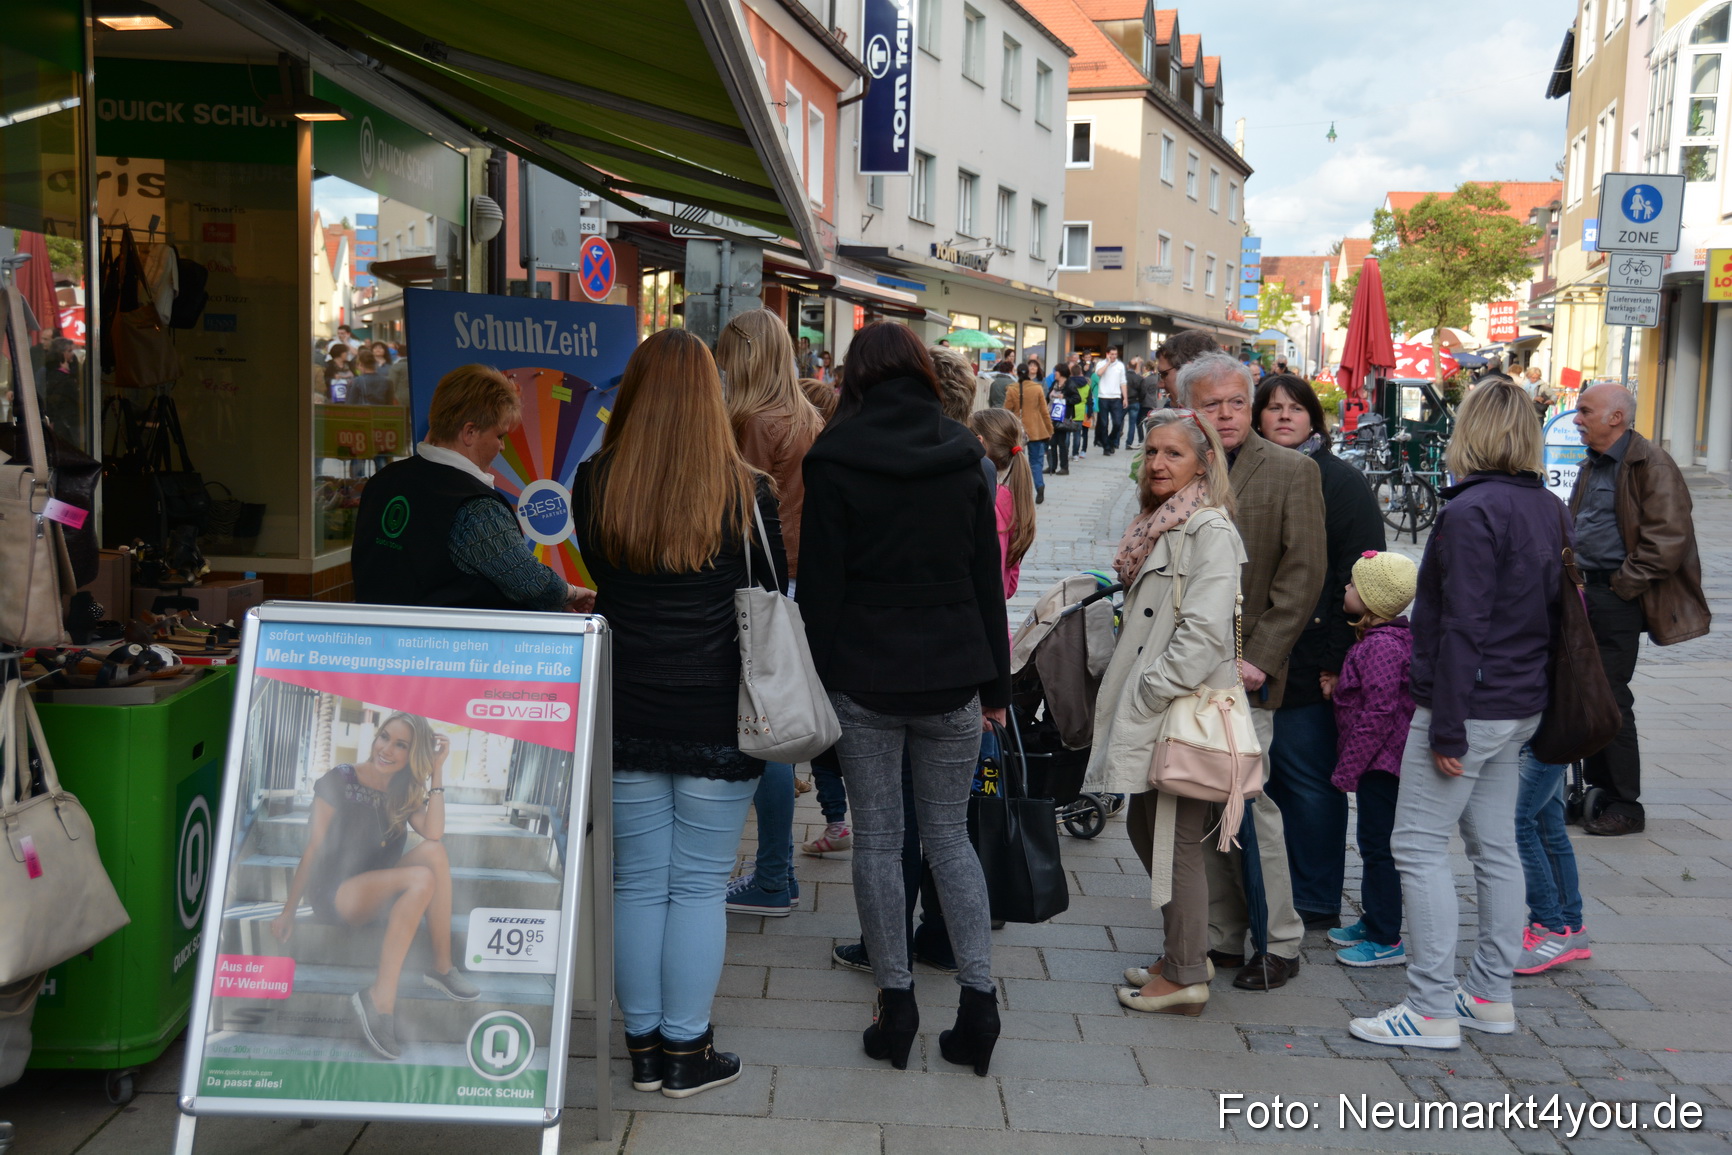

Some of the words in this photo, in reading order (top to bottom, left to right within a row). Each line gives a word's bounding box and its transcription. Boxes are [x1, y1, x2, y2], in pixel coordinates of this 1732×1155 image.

[97, 98, 186, 123] QUICK
[893, 74, 907, 152] TOM
[377, 139, 406, 178] QUICK
[1618, 231, 1660, 244] ZONE
[1626, 277, 1643, 286] frei
[1613, 296, 1652, 304] Lieferverkehr
[1490, 305, 1514, 316] ALLES
[1609, 304, 1636, 313] werktags
[1092, 314, 1126, 324] O'Polo
[1490, 315, 1514, 325] MUSS
[1625, 314, 1638, 322] frei
[454, 311, 598, 357] SchuhZeit!
[1549, 469, 1561, 487] 3
[520, 496, 563, 518] BEST
[541, 508, 567, 520] PARTNER
[269, 629, 305, 642] sofort
[307, 631, 372, 646] wohlfühlen
[398, 636, 449, 650] natürlich
[453, 639, 489, 653] gehen
[514, 641, 574, 655] ultraleicht
[265, 647, 305, 664] Mehr
[308, 650, 465, 673] Bewegungsspielraum
[469, 658, 490, 674] für
[492, 660, 533, 676] deine
[536, 661, 572, 677] Füße
[483, 689, 558, 701] skechers
[488, 916, 547, 925] SKECHERS
[173, 943, 192, 973] QUICK
[220, 960, 243, 973] Aus
[245, 962, 265, 973] der
[218, 976, 289, 993] TV-Werbung
[208, 1069, 273, 1078] www.quick-schuh.com
[206, 1076, 221, 1087] Da
[223, 1078, 253, 1088] passt
[254, 1079, 283, 1089] alles!
[457, 1086, 493, 1097] QUICK
[495, 1088, 535, 1099] SCHUH
